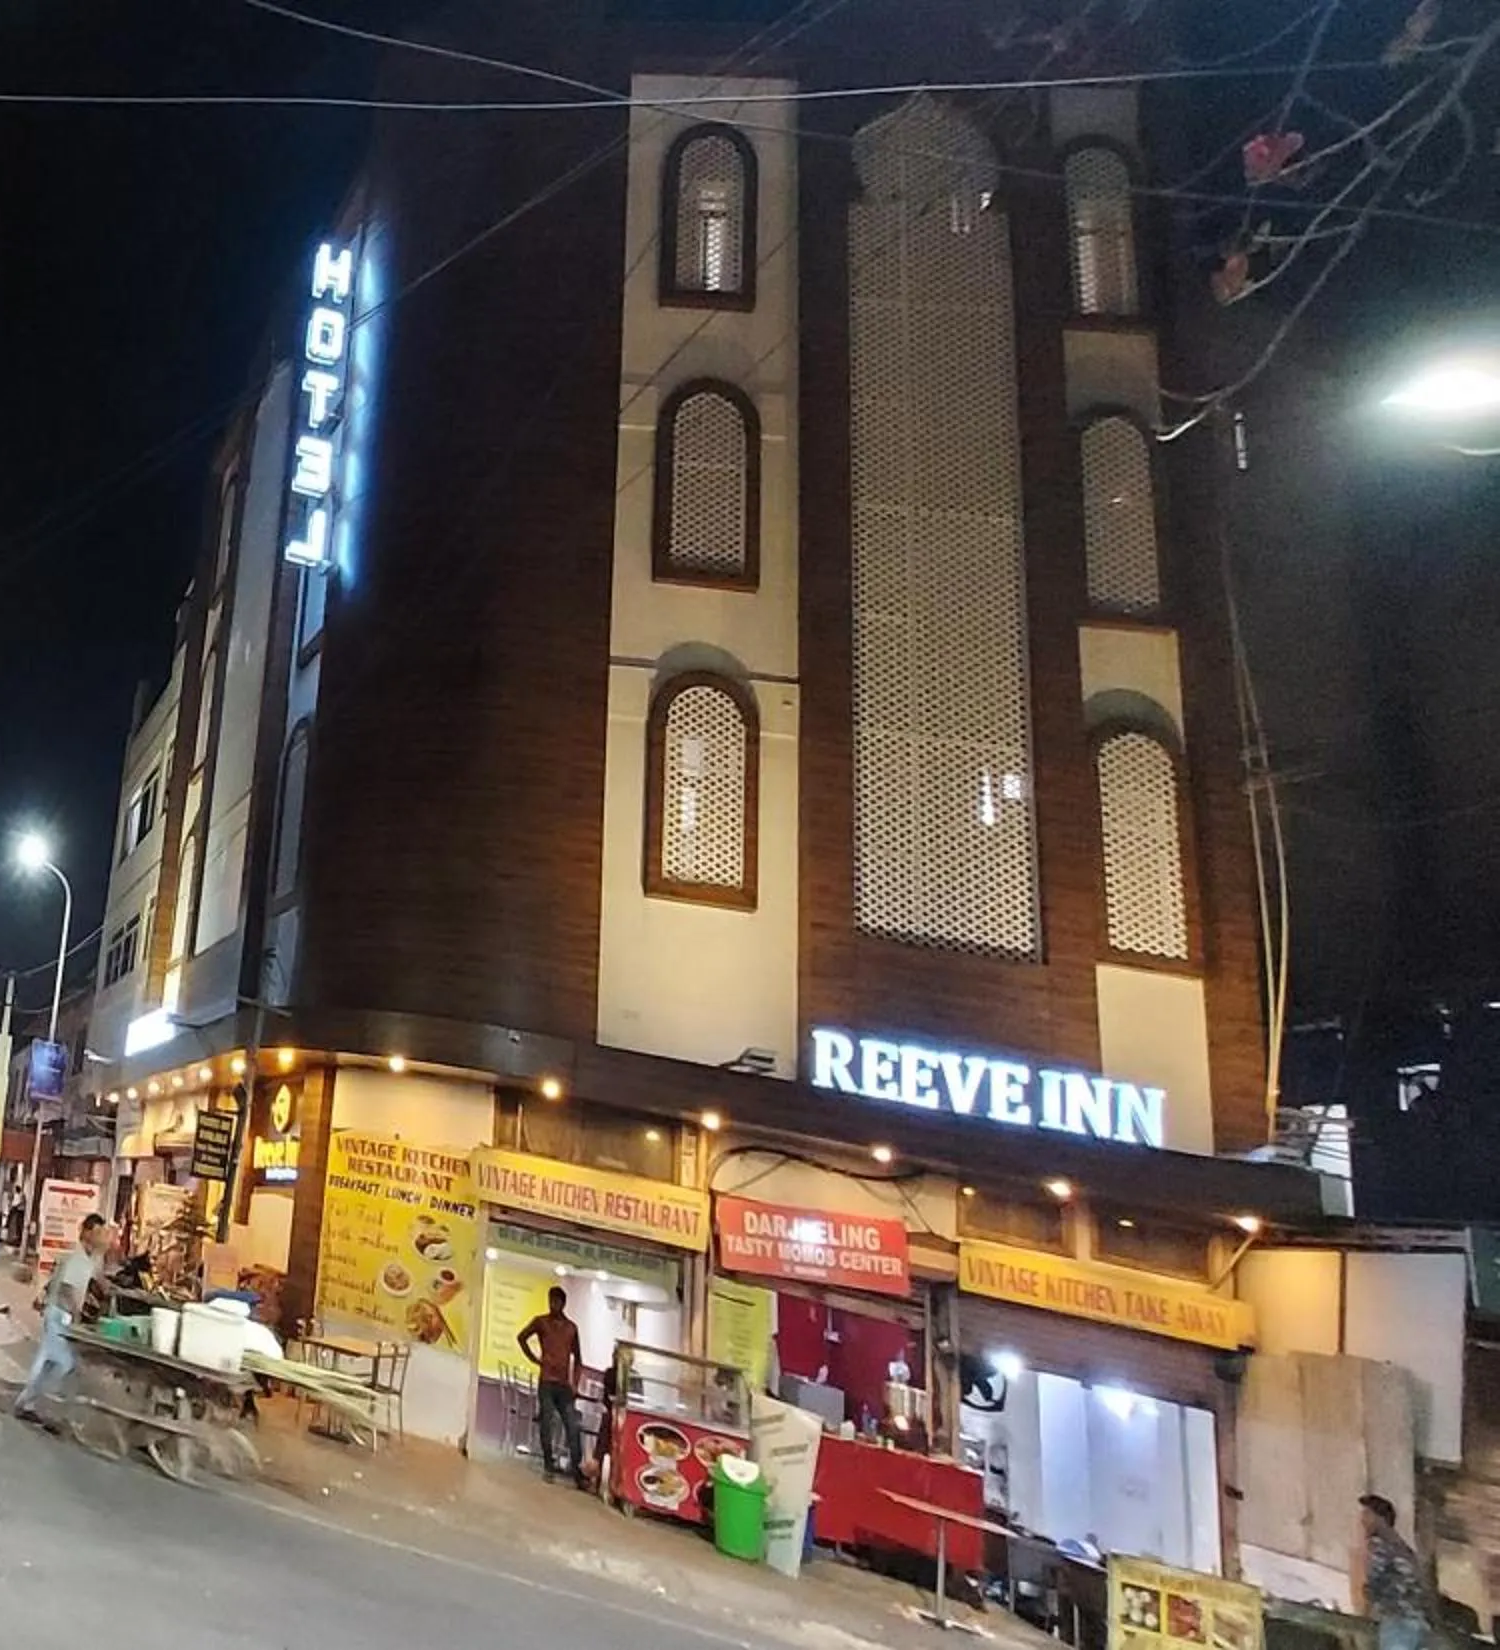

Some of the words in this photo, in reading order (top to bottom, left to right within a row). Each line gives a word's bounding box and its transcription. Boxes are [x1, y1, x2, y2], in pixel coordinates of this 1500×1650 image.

[810, 1028, 1034, 1126] REEVE
[1037, 1068, 1168, 1147] INN
[336, 1136, 397, 1162] VINTAGE
[402, 1147, 472, 1178] KITCHEN
[348, 1156, 454, 1193] RESTAURANT
[386, 1187, 422, 1205] LUNCH
[430, 1196, 477, 1219] DINNER
[477, 1162, 537, 1199] VINTAGE
[541, 1177, 599, 1213] KITCHEN
[603, 1191, 702, 1238] RESTAURANT
[743, 1211, 881, 1251] DARJELING
[725, 1234, 774, 1258] TASTY
[777, 1242, 837, 1268] MOMOS
[839, 1252, 903, 1277] CENTER
[965, 1256, 1040, 1297] VINTAGE
[1045, 1272, 1117, 1315] KITCHEN
[1123, 1290, 1172, 1327] TAKE
[1177, 1302, 1229, 1338] AWAY
